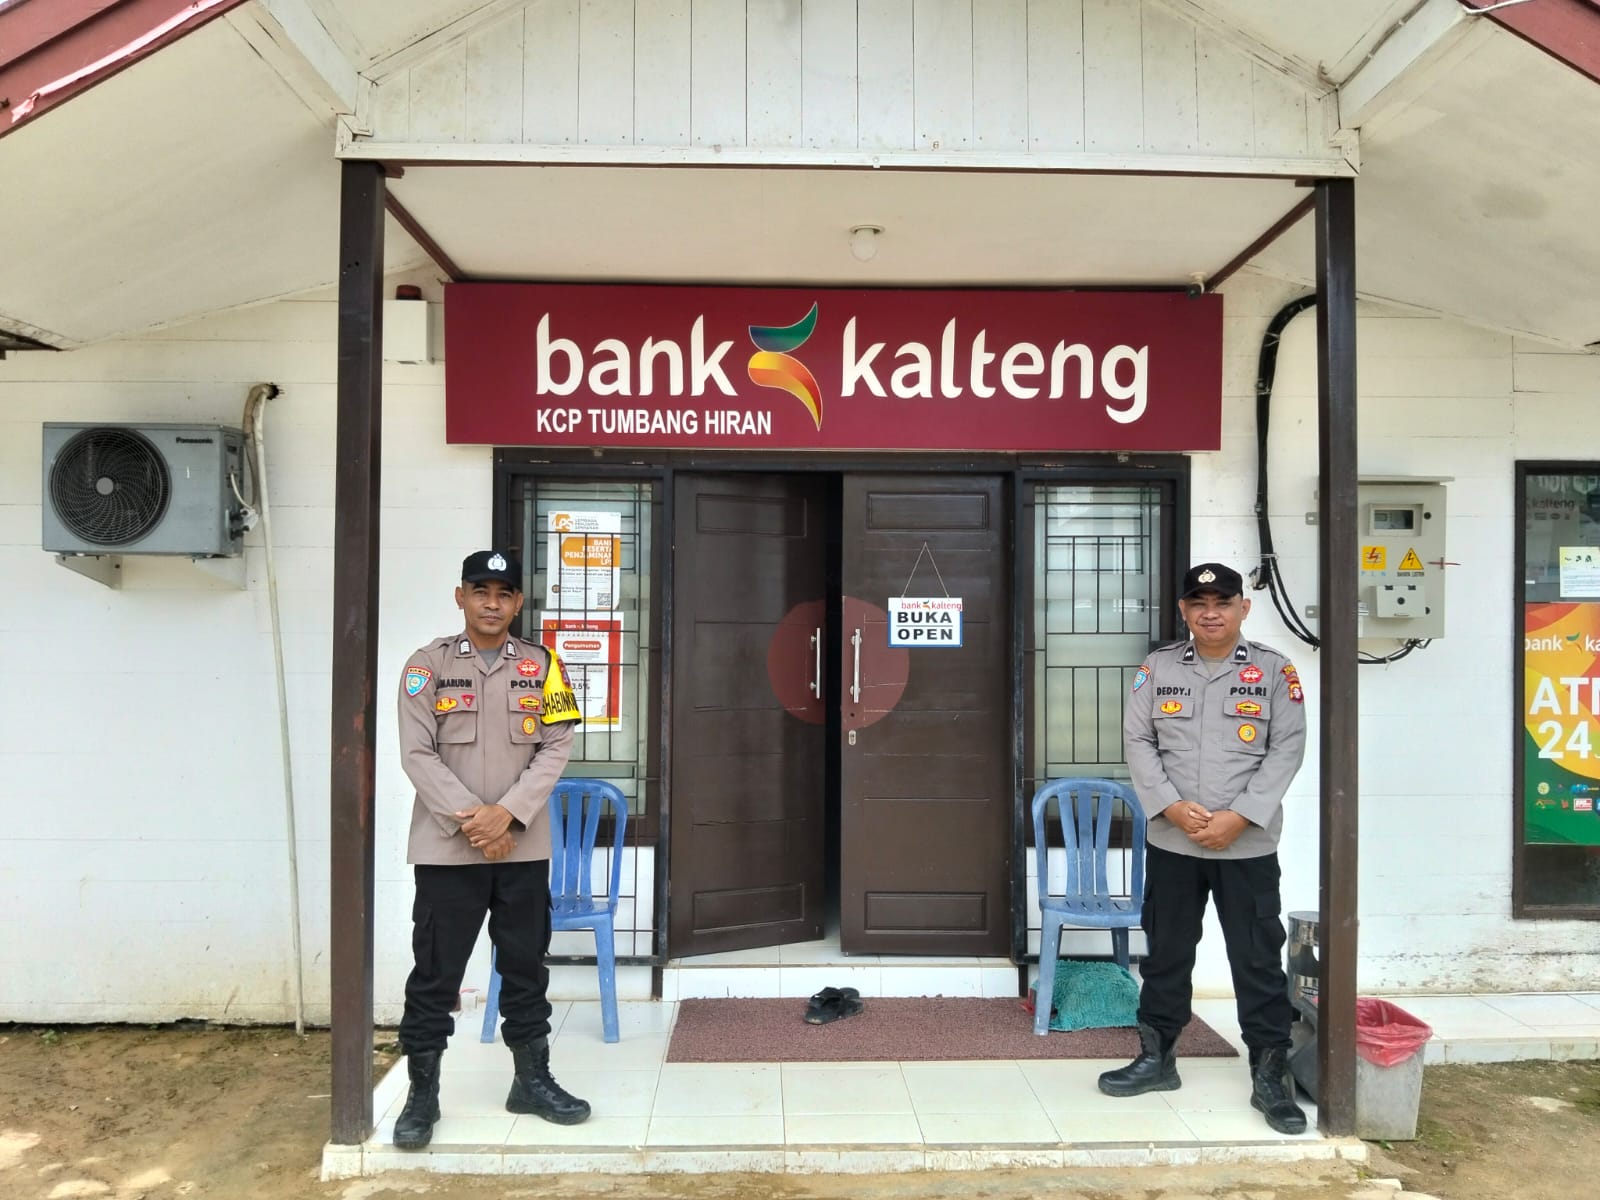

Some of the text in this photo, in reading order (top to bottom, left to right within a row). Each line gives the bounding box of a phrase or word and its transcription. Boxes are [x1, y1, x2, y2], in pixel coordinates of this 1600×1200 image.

[536, 312, 1150, 424] bank kalteng
[536, 408, 772, 435] KCP TUMBANG HIRAN
[175, 436, 214, 444] Panasonic
[901, 601, 963, 612] bank kalteng
[897, 611, 952, 624] BUKA
[897, 628, 953, 641] OPEN
[1230, 686, 1267, 697] POLRI
[1538, 720, 1592, 759] 24
